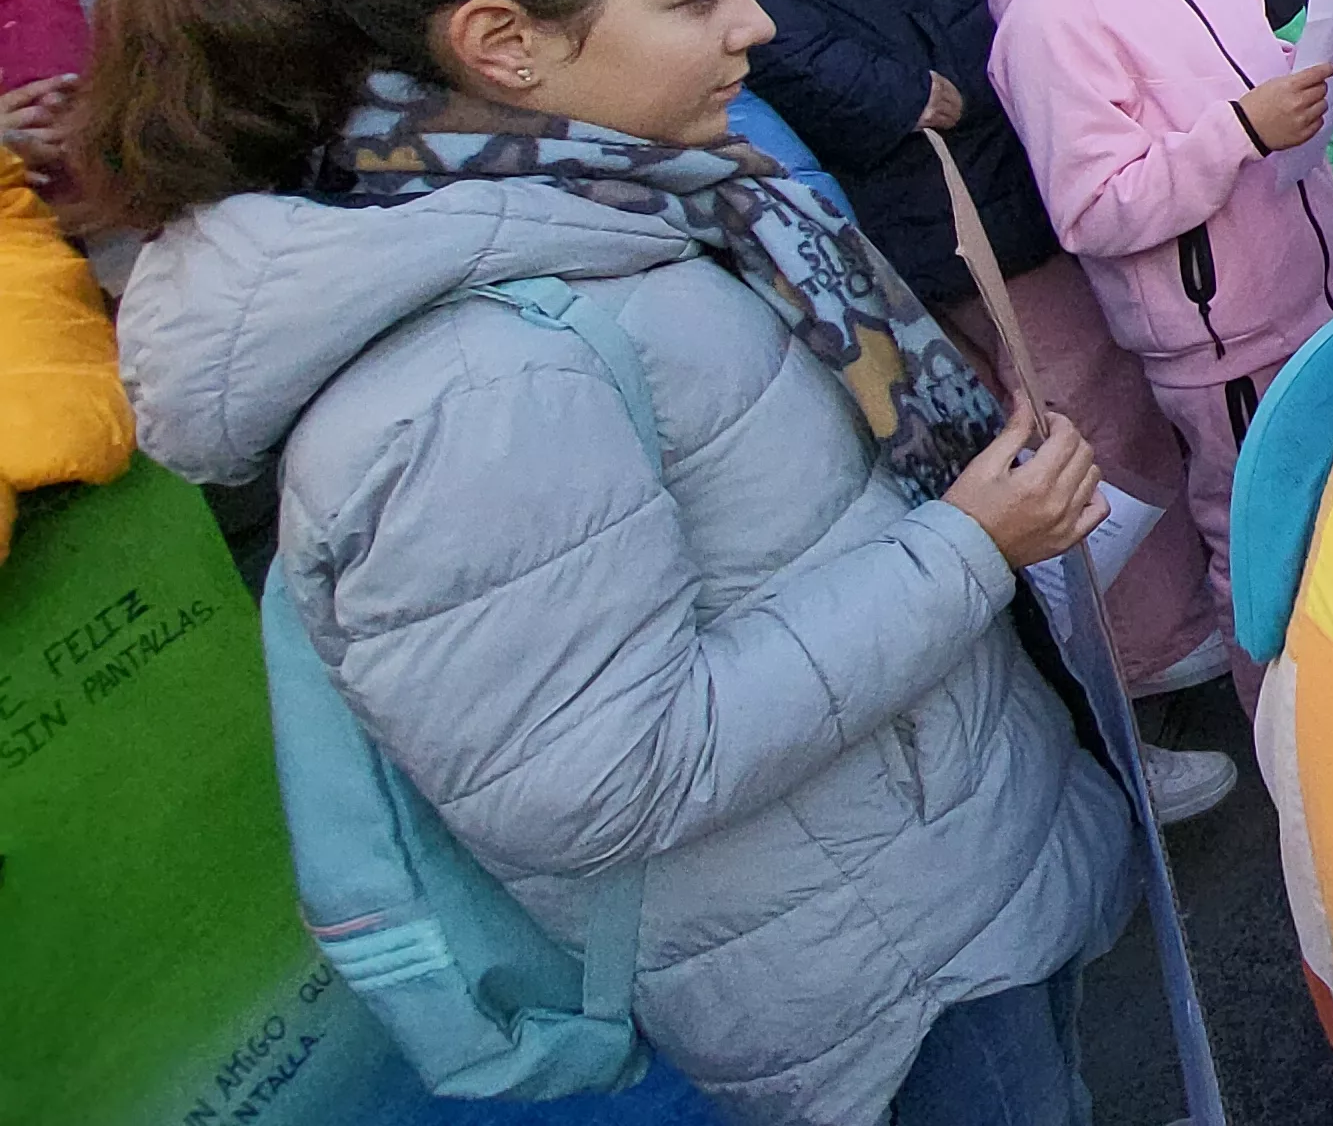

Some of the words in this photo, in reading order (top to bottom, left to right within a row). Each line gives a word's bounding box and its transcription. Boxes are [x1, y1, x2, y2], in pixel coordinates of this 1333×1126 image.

[43, 588, 154, 678] FELIZ
[0, 698, 68, 769] SIN
[300, 963, 339, 1004] QU
